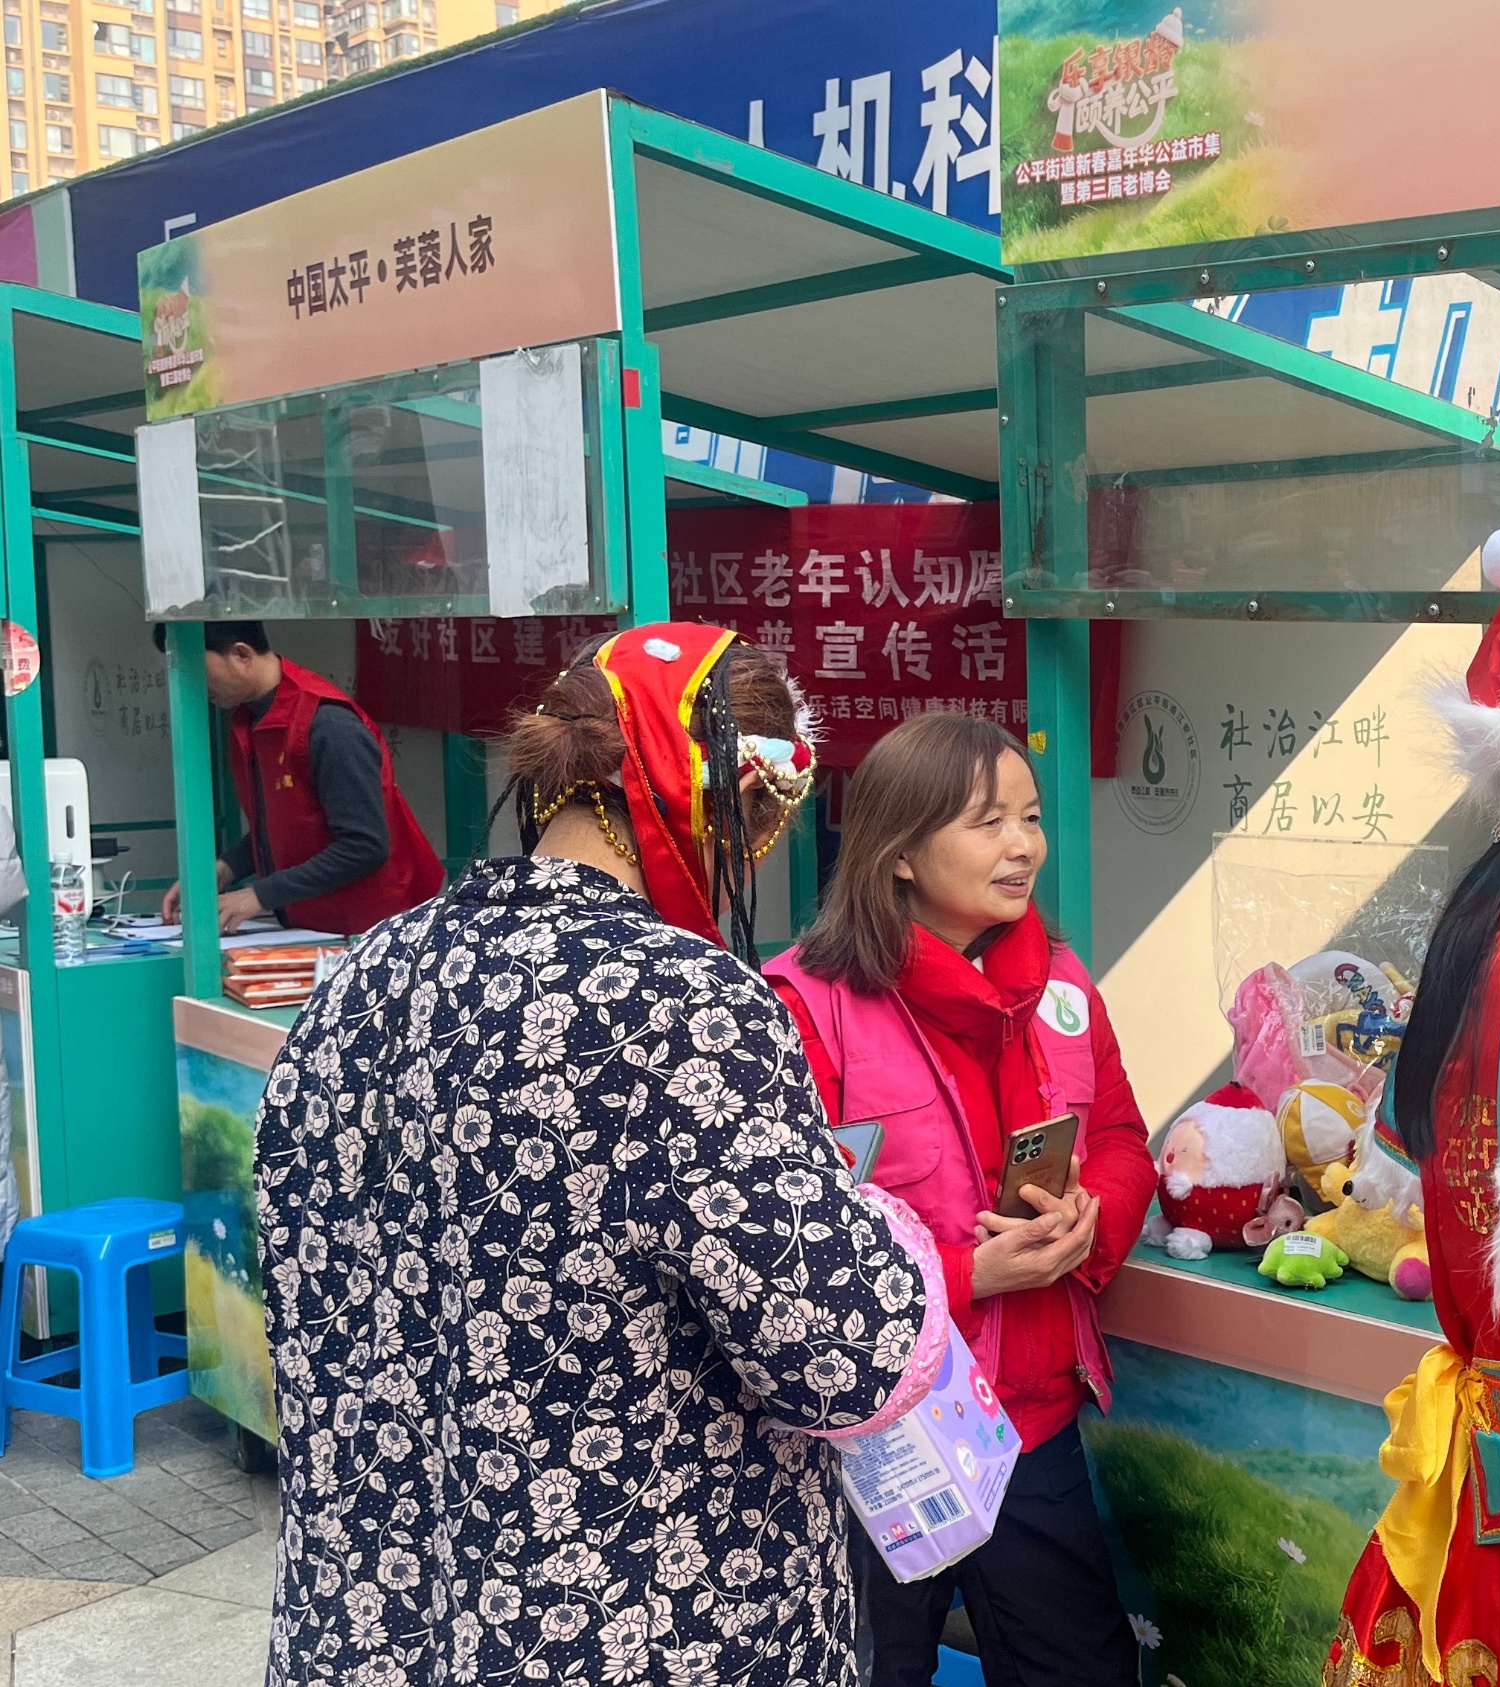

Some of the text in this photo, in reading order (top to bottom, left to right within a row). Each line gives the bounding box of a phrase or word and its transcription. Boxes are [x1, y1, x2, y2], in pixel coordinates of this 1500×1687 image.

[1061, 31, 1180, 92] 乐享银龄
[1074, 69, 1179, 136] 颐养公平
[1015, 132, 1221, 186] 公平街道新春嘉年华公益市集
[1060, 167, 1171, 207] 暨第三届老博会
[1220, 703, 1390, 768] 社治江畔
[1222, 774, 1393, 842] 商居以安
